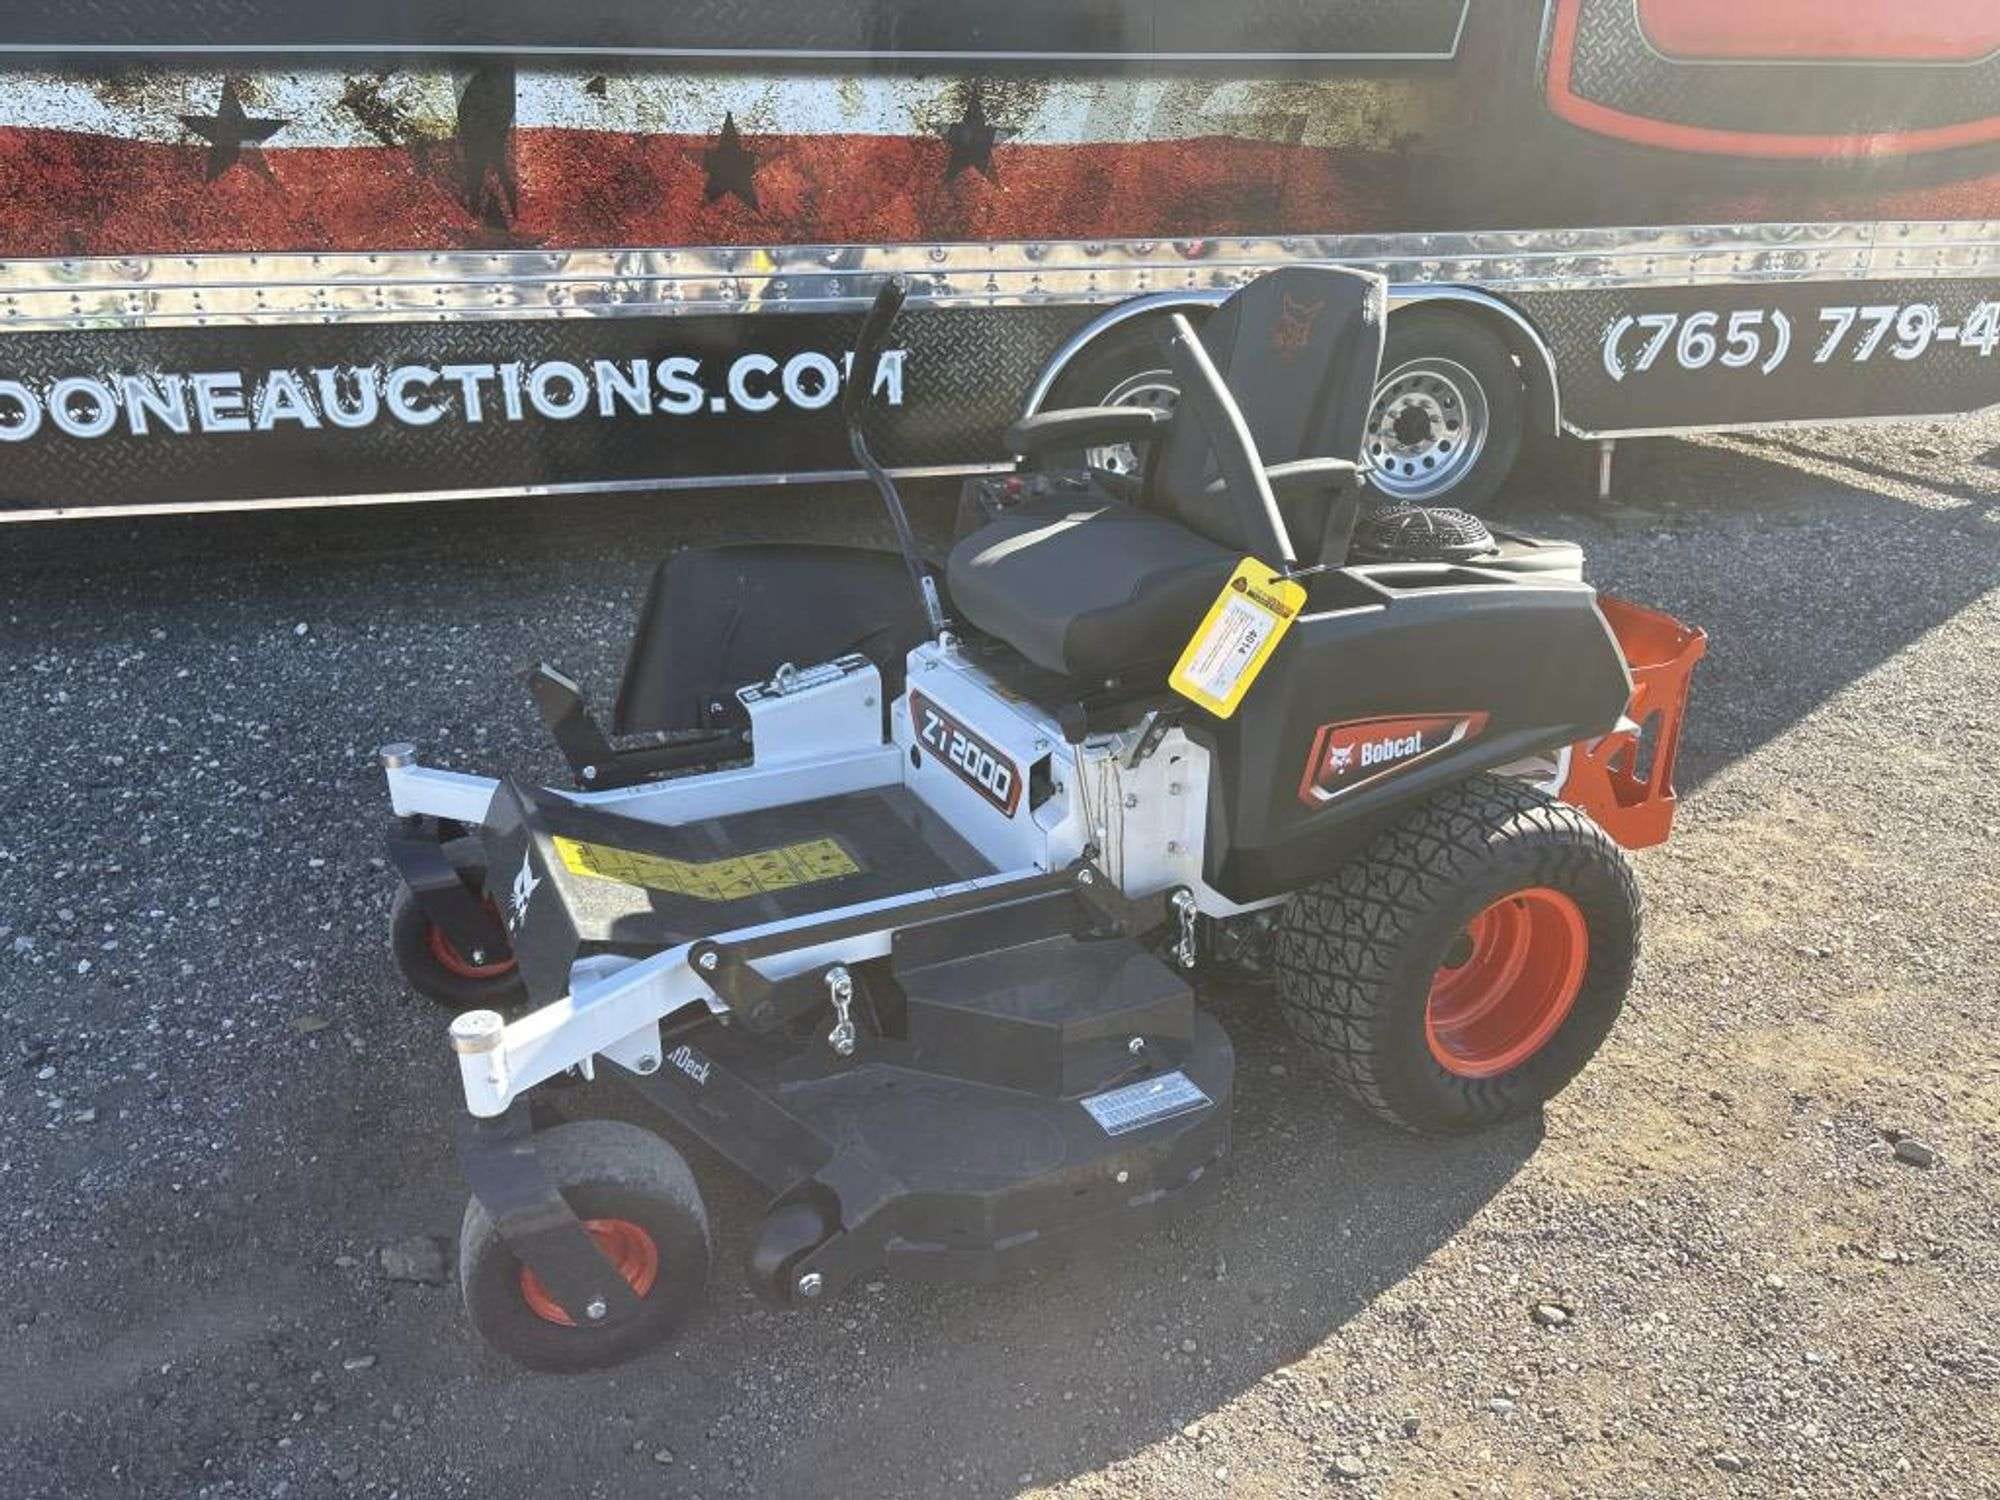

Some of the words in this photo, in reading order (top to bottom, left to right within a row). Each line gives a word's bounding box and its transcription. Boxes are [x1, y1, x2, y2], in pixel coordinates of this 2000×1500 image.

[1602, 309, 1791, 381] (765)
[1813, 301, 2000, 363] 779-4
[1238, 629, 1258, 654] 4014
[1360, 730, 1422, 767] Bobcat
